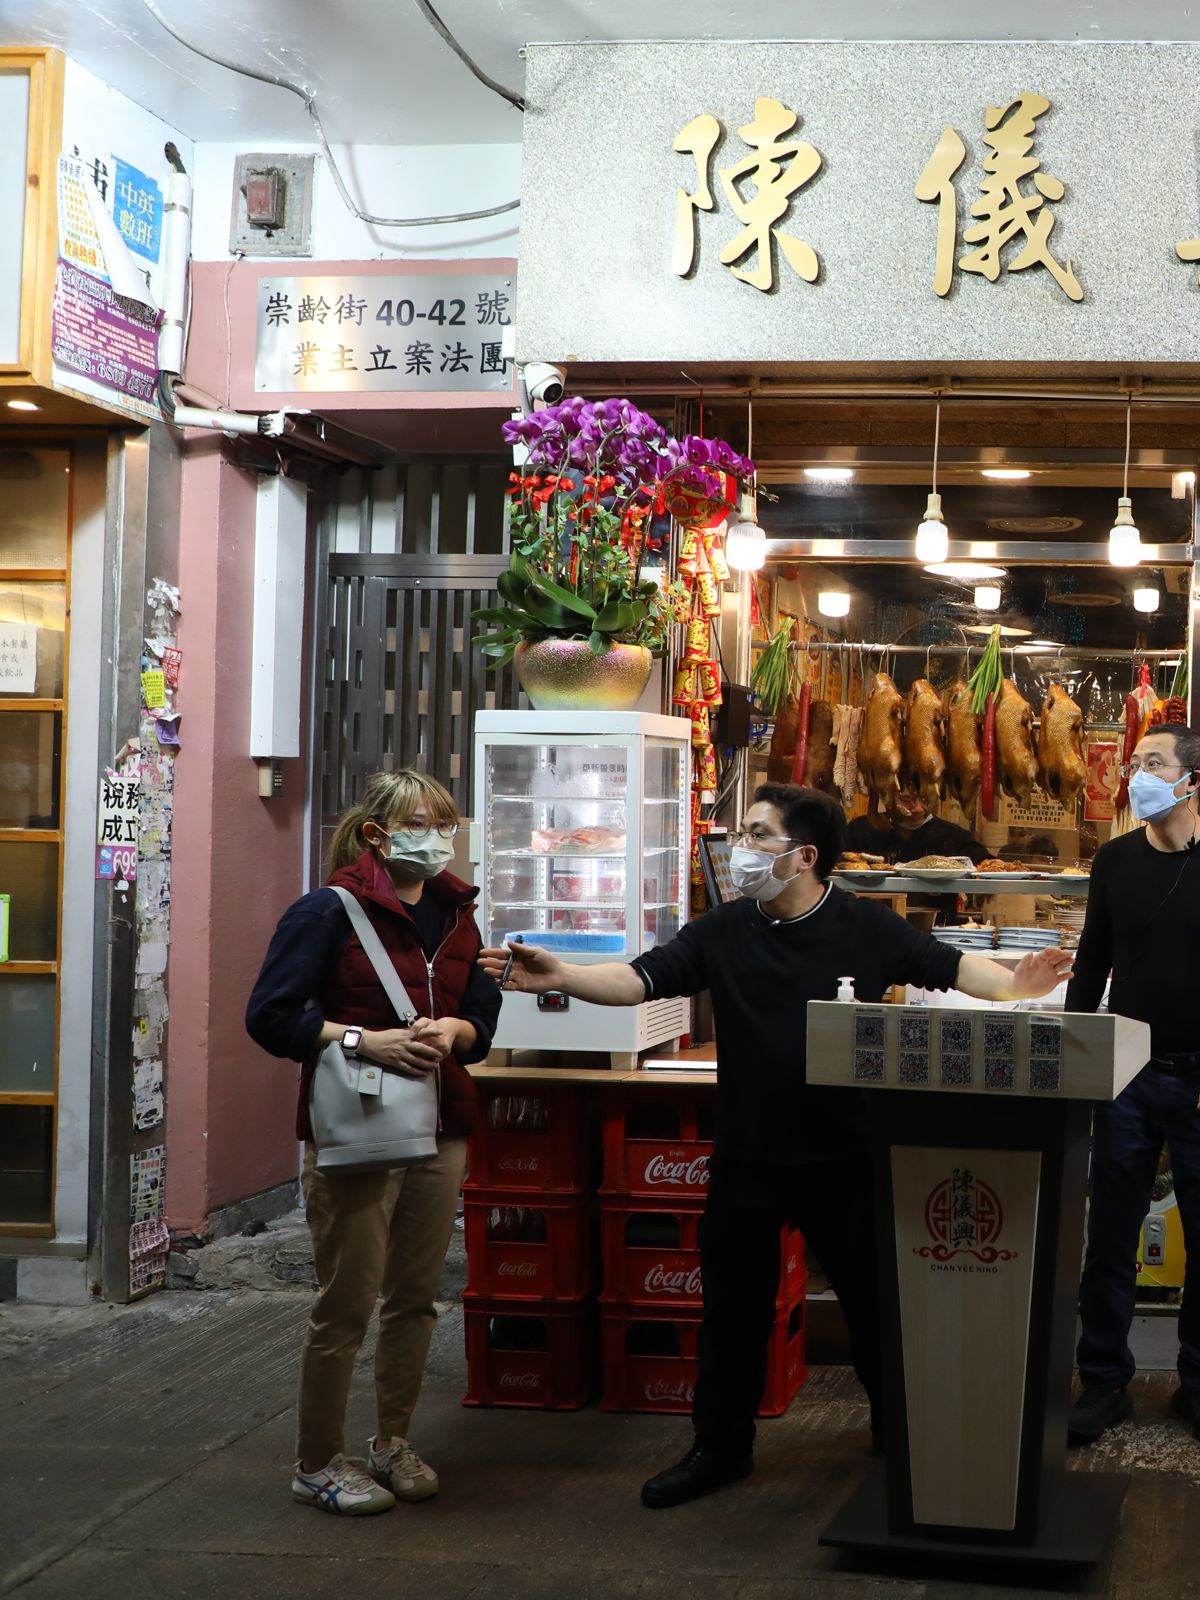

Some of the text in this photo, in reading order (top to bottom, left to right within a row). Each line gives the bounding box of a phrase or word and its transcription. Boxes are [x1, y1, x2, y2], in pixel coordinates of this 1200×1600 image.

[120, 181, 156, 221] 中英
[119, 208, 154, 250] 數班
[265, 290, 512, 327] 崇齡街 40-42 號
[292, 340, 507, 376] 業主立案法團
[644, 1154, 711, 1185] Coca-Co
[952, 1167, 977, 1249] 陳儀興
[930, 1264, 999, 1274] CHAN YEE HING
